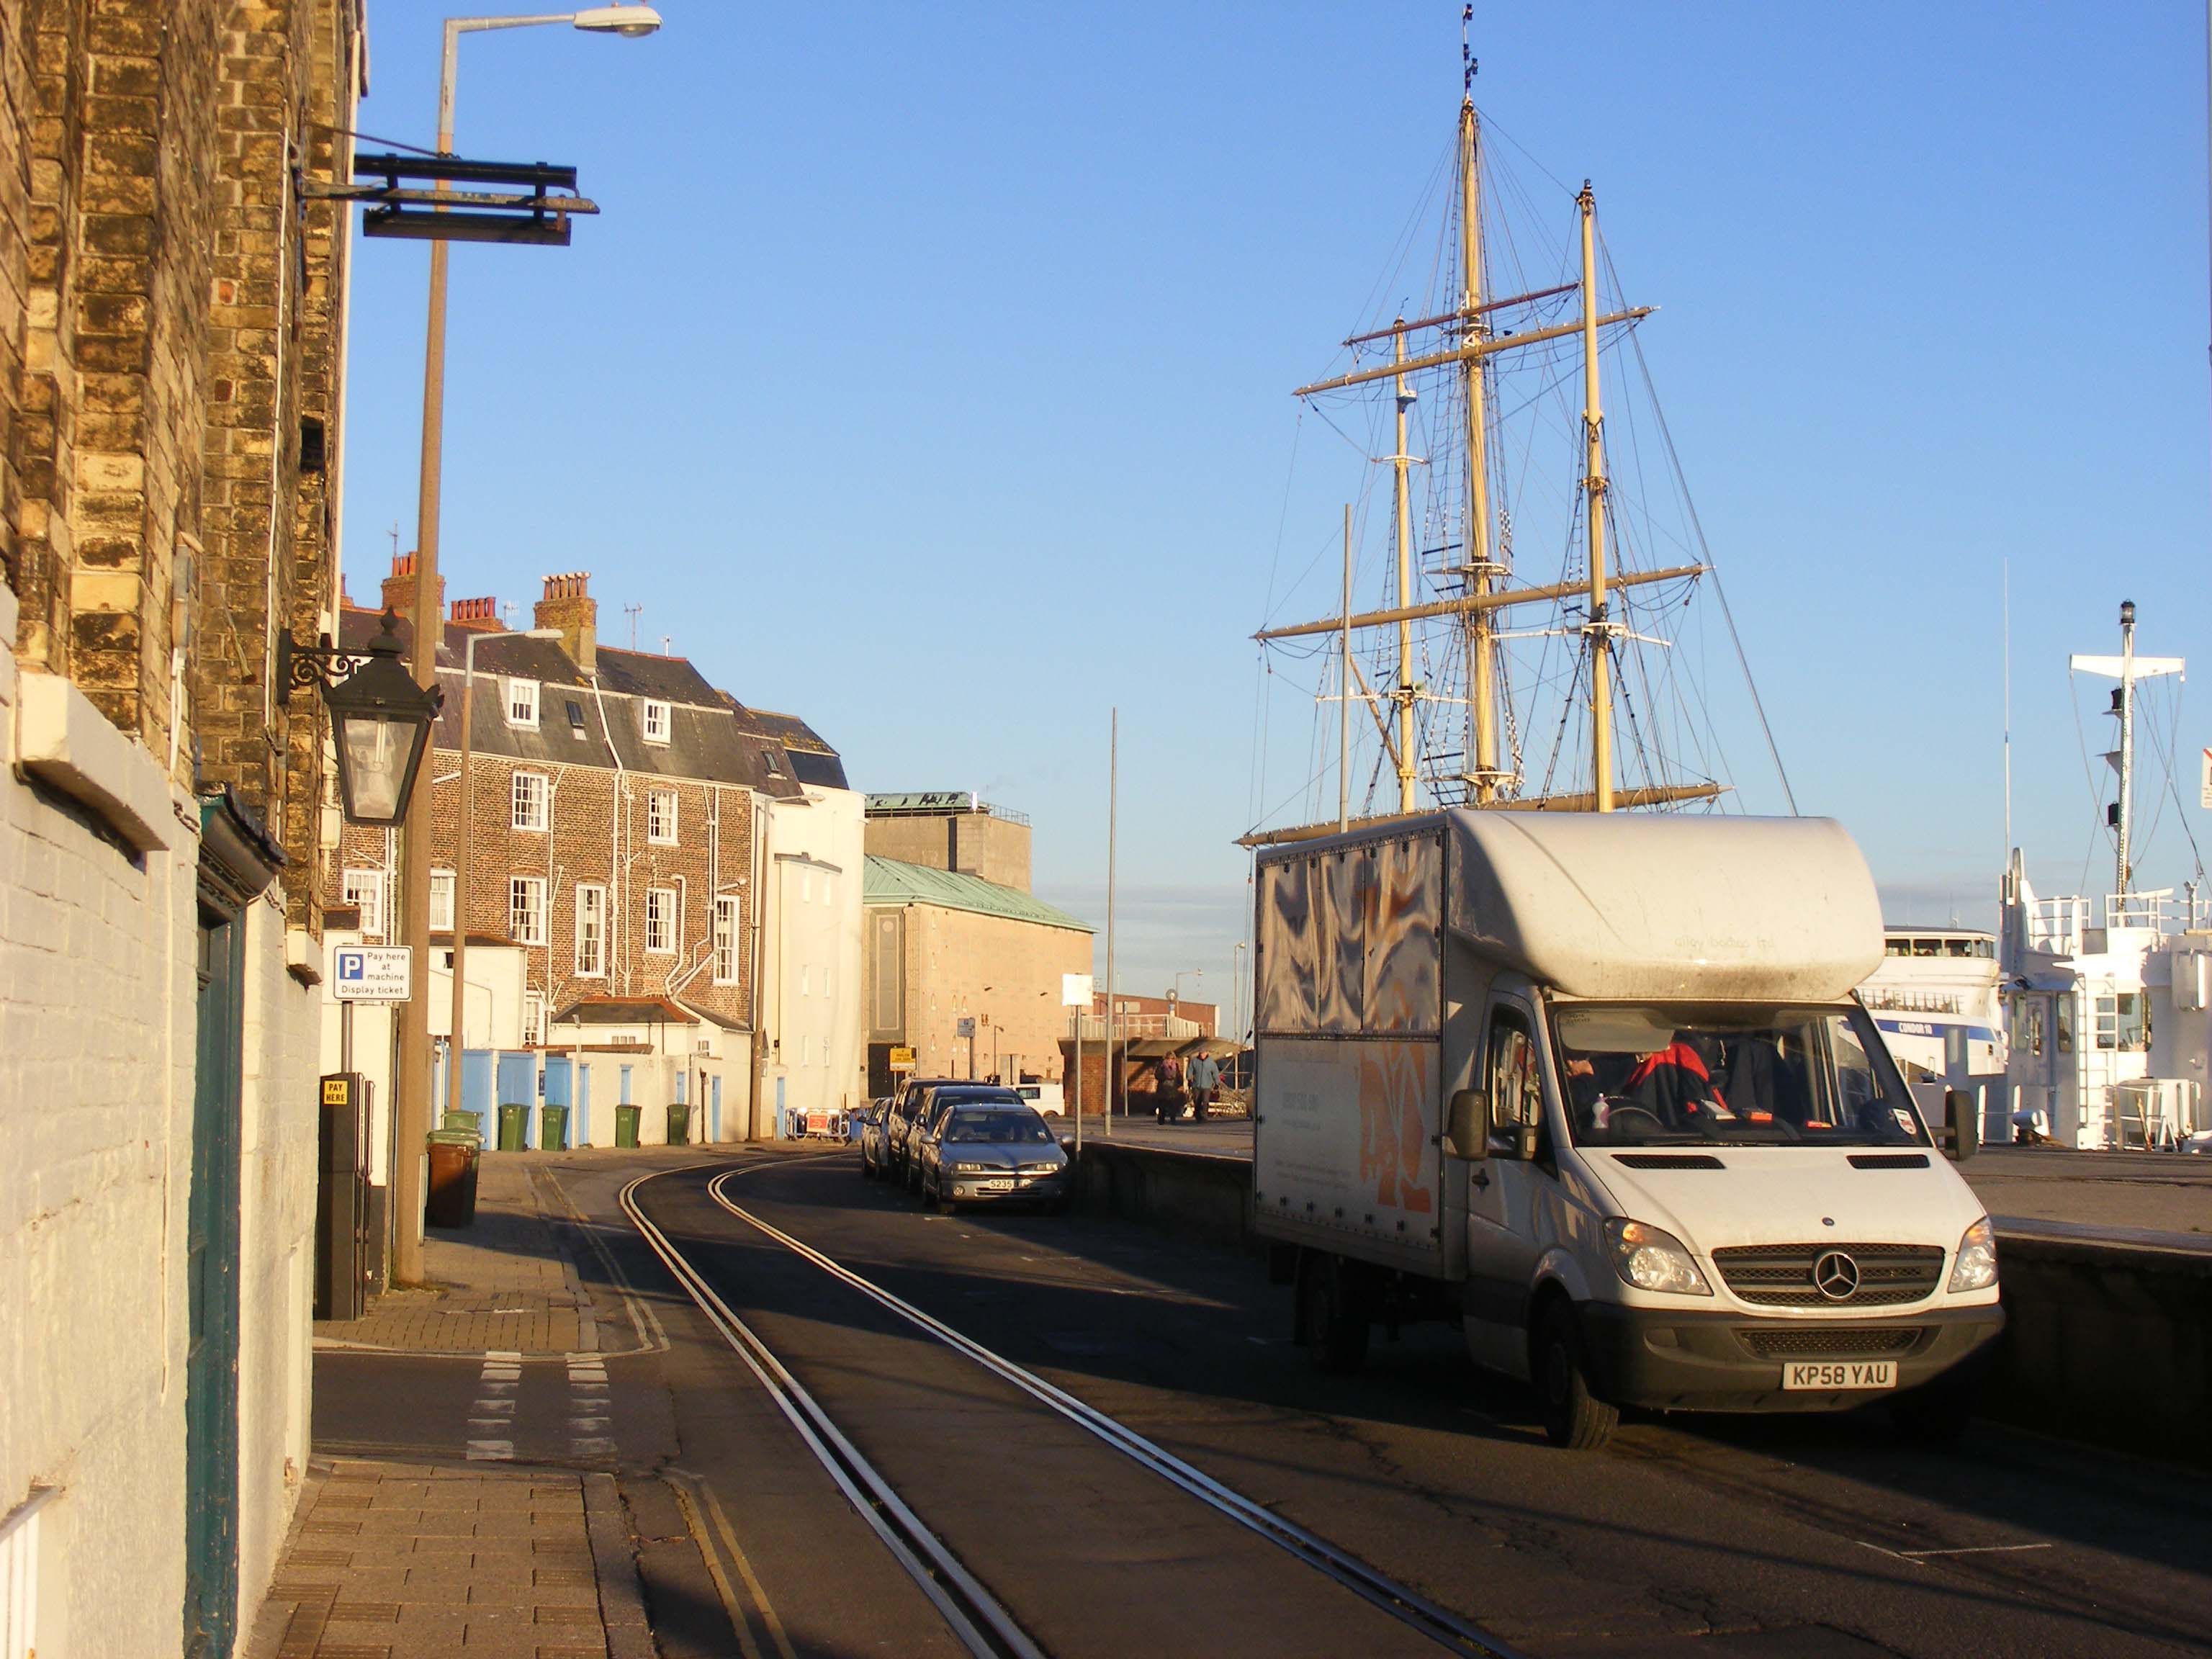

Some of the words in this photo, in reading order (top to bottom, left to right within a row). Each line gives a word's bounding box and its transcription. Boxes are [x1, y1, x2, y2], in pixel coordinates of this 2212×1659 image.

[367, 952, 383, 961] Pay
[345, 956, 361, 978] P
[341, 985, 374, 994] Display
[1793, 1365, 1845, 1385] KP58
[1851, 1364, 1888, 1384] YAU
